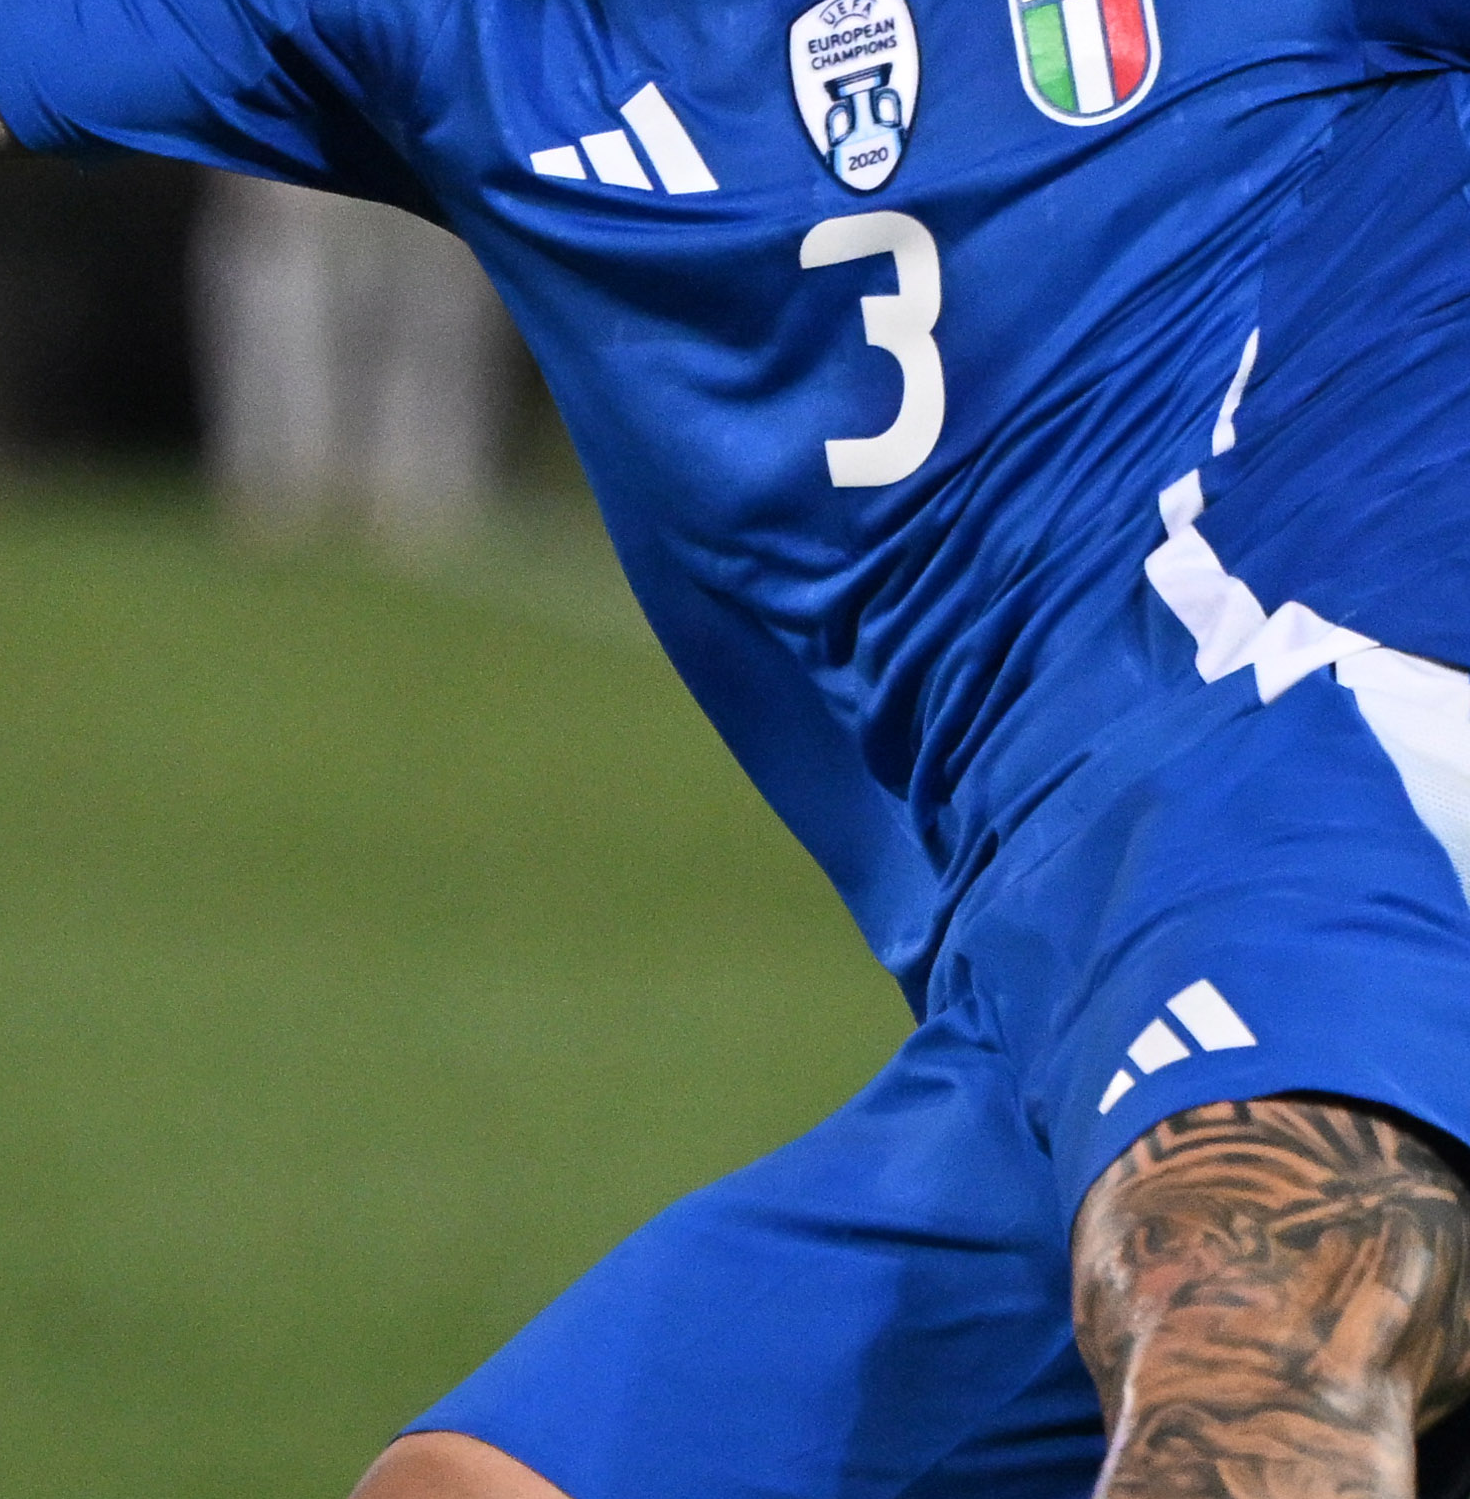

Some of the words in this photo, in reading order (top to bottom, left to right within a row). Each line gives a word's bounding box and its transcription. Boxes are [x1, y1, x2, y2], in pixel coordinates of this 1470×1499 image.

[807, 17, 896, 55] EUROPEAN
[811, 34, 898, 71] CHAMPIONS
[848, 146, 890, 172] 2020
[799, 209, 946, 488] 3
